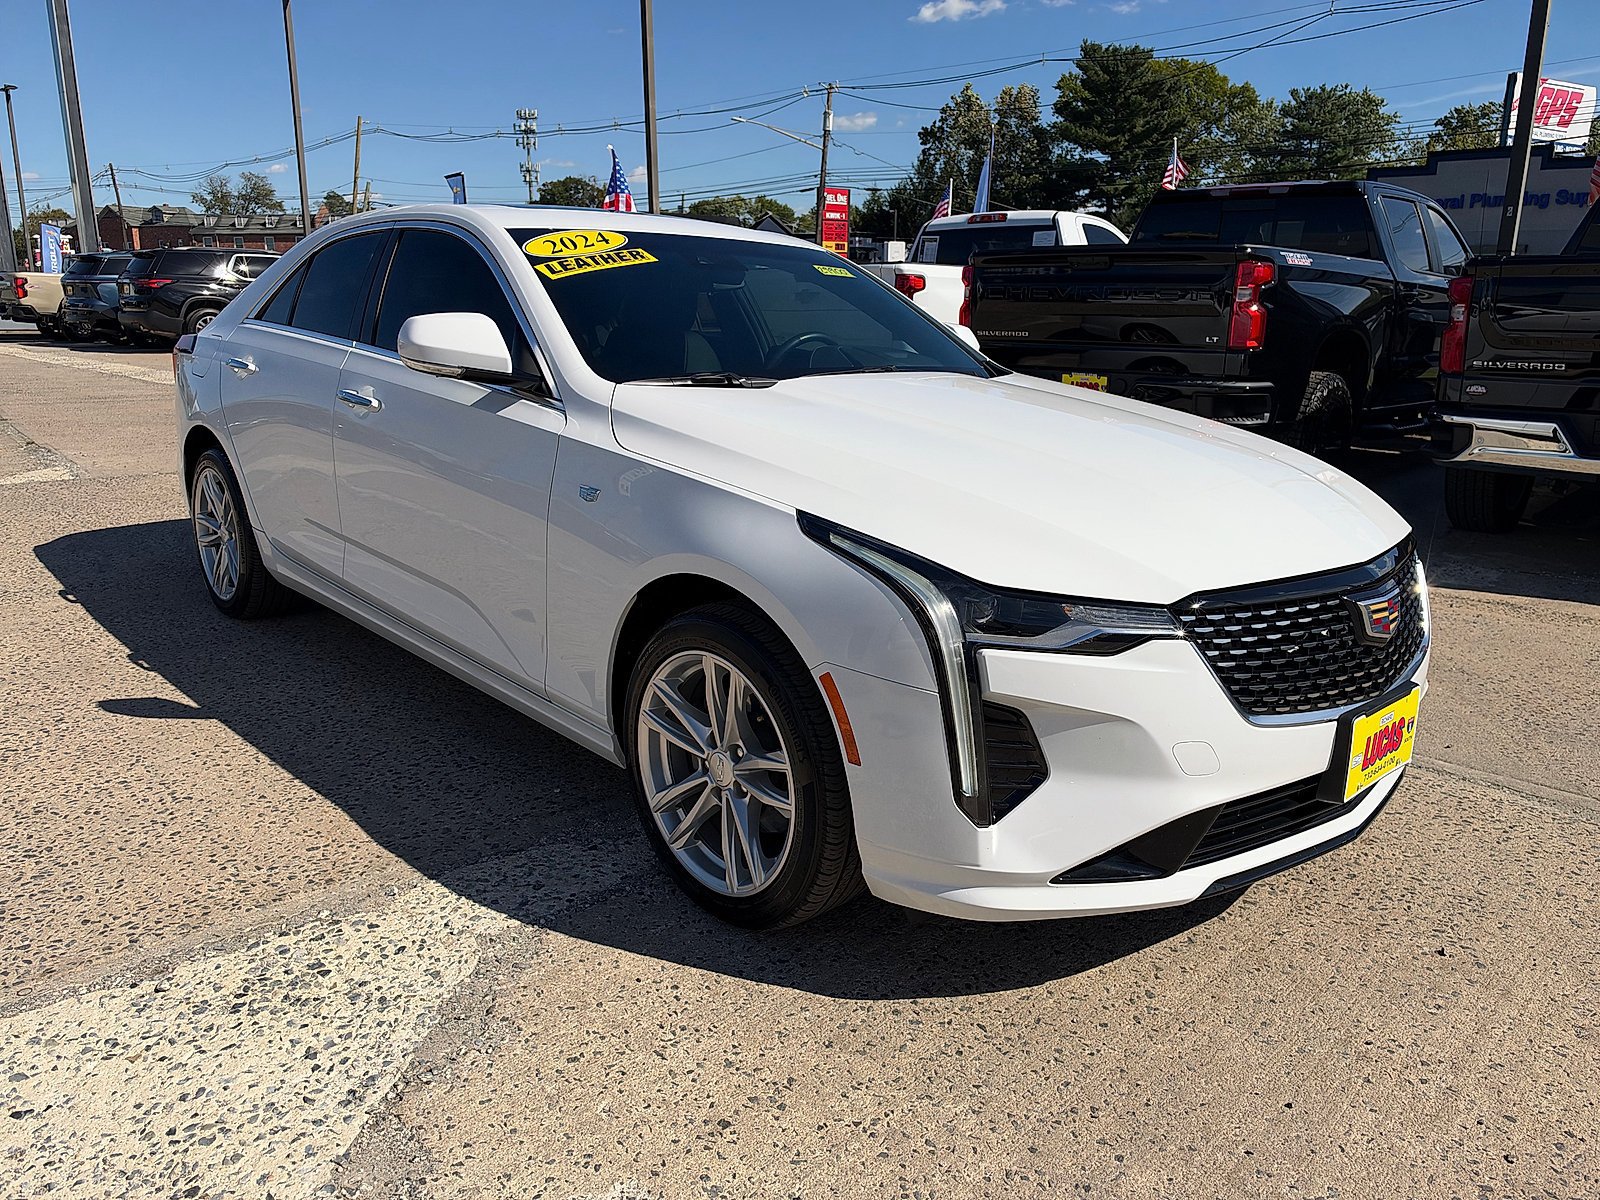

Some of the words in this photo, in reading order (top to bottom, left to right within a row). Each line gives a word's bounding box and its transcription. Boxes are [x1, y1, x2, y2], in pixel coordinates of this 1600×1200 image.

[1534, 87, 1584, 128] GPS
[1438, 194, 1465, 209] eral
[1469, 191, 1550, 209] Pluming
[1555, 189, 1590, 208] Sup
[1506, 206, 1514, 217] 2
[543, 232, 610, 254] 2024
[543, 250, 648, 275] LEATHER
[1473, 360, 1566, 371] SILVERADO
[1466, 385, 1487, 393] LUCAS
[1361, 717, 1405, 772] LUCAS
